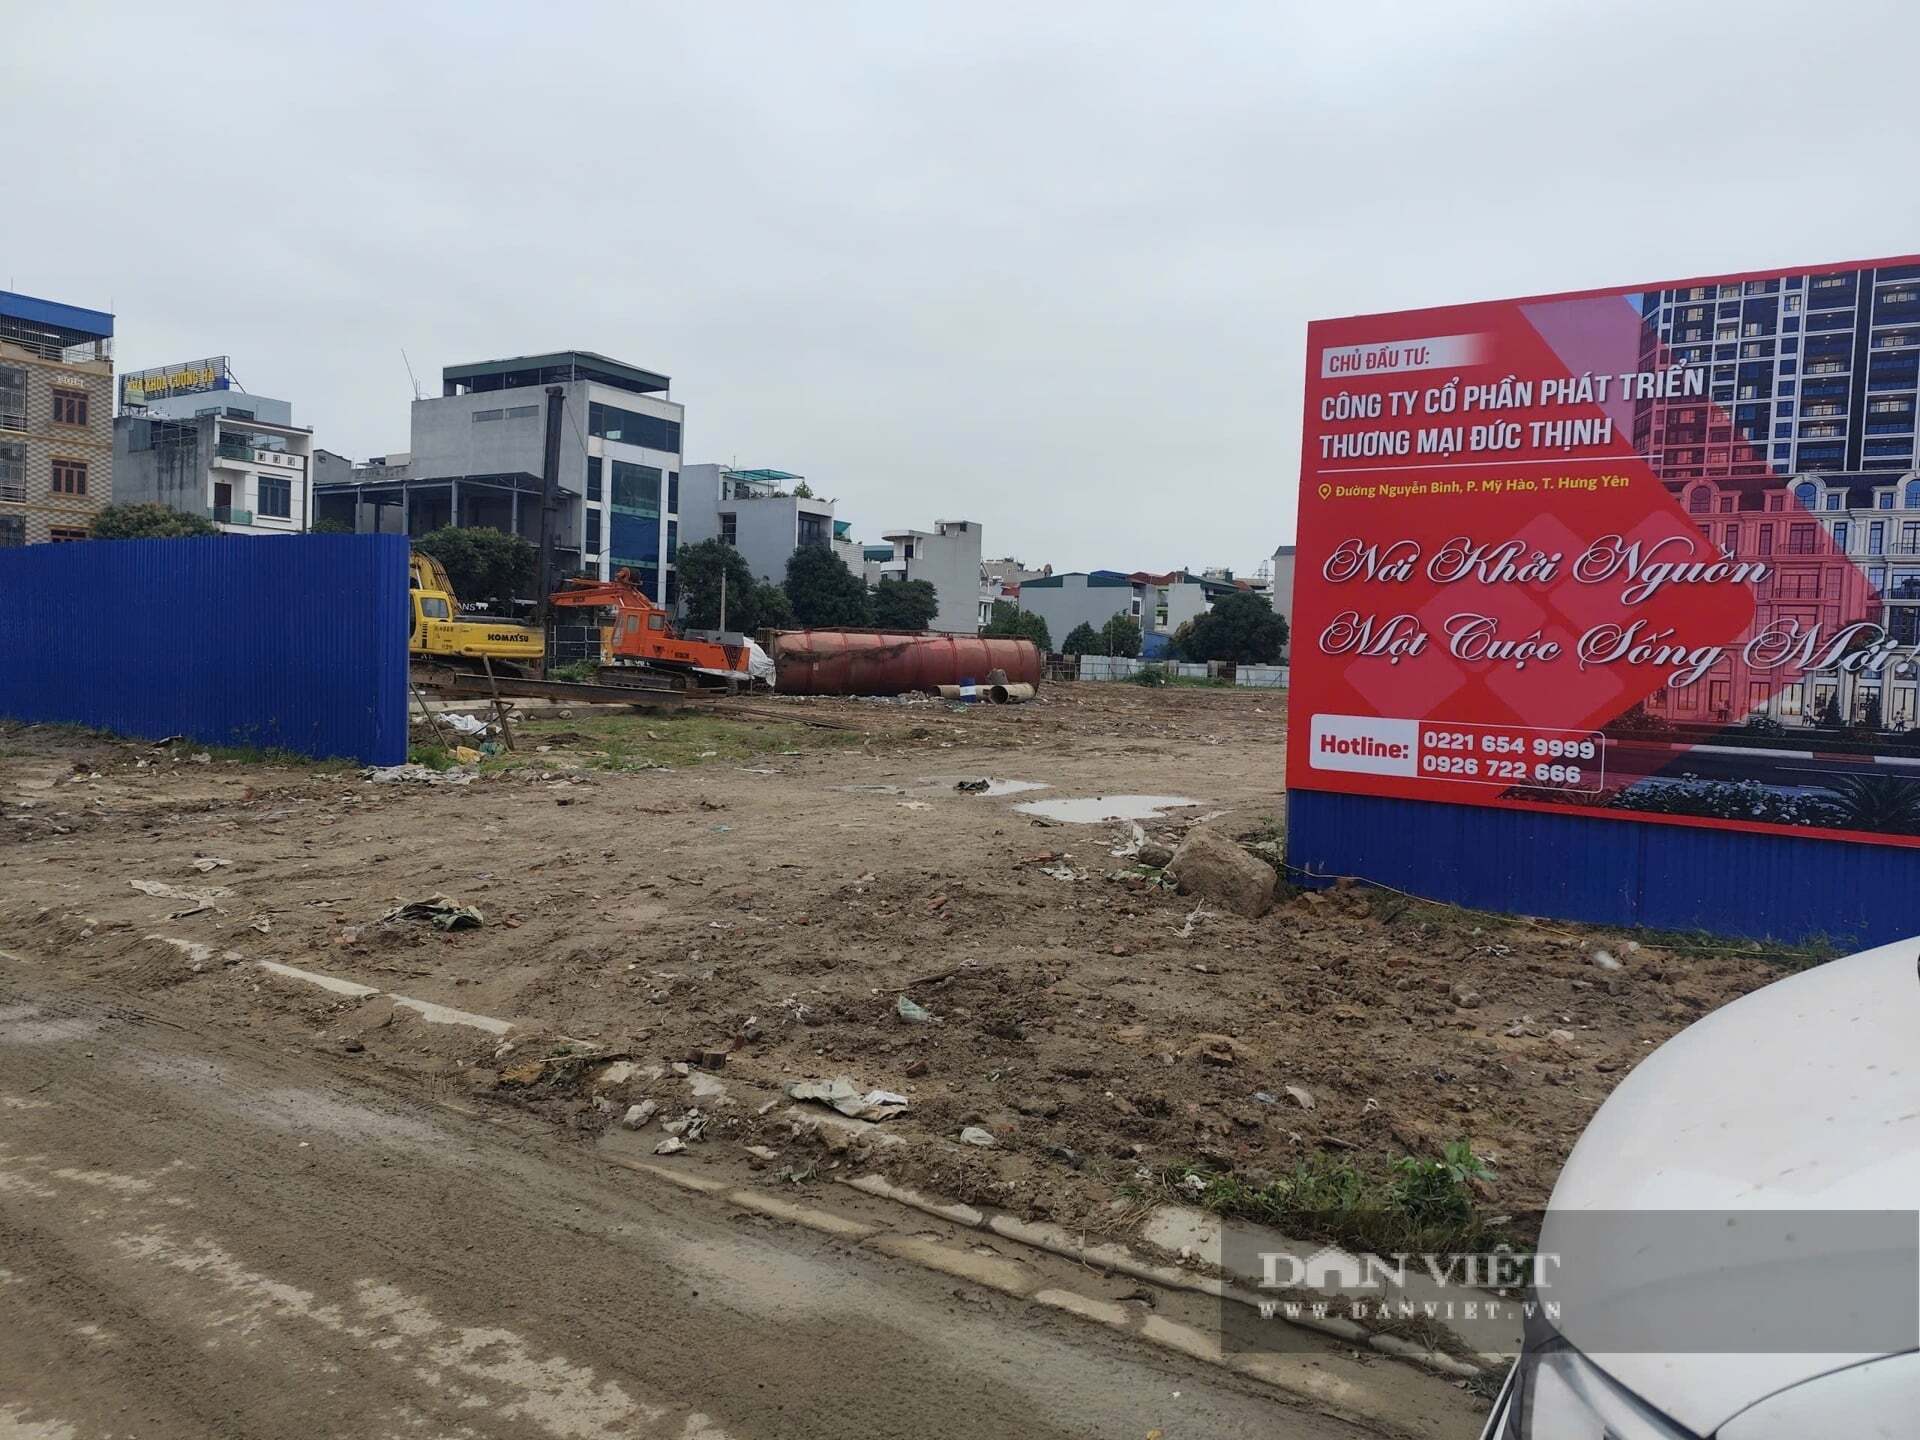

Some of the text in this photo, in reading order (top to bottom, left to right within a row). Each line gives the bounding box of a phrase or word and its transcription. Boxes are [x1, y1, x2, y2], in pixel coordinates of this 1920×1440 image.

[1329, 345, 1430, 373] CHỦ ĐẦU TƯ:
[1321, 358, 1704, 421] CÔNG TY CỔ PHẦN PHÁT TRIỂN
[1319, 417, 1612, 459] THƯƠNG MẠI ĐỨC THỊNH
[1336, 484, 1376, 498] Đường
[1379, 480, 1427, 497] Nguyễn
[1466, 480, 1479, 492] P.
[1482, 478, 1502, 494] Mỹ
[1506, 477, 1538, 492] Hào,
[1542, 477, 1554, 489] T.
[1601, 474, 1629, 488] Yên
[1322, 534, 1774, 605] Nơi Khởi Nguồn
[488, 633, 529, 643] KOMATSU
[1319, 611, 1428, 665] Một
[1444, 613, 1563, 670] Cuộc
[1577, 619, 1726, 688] Sống
[1320, 734, 1409, 760] Hotline:
[1423, 731, 1595, 760] 0221 654 9999
[1423, 755, 1581, 784] 0926 722 666
